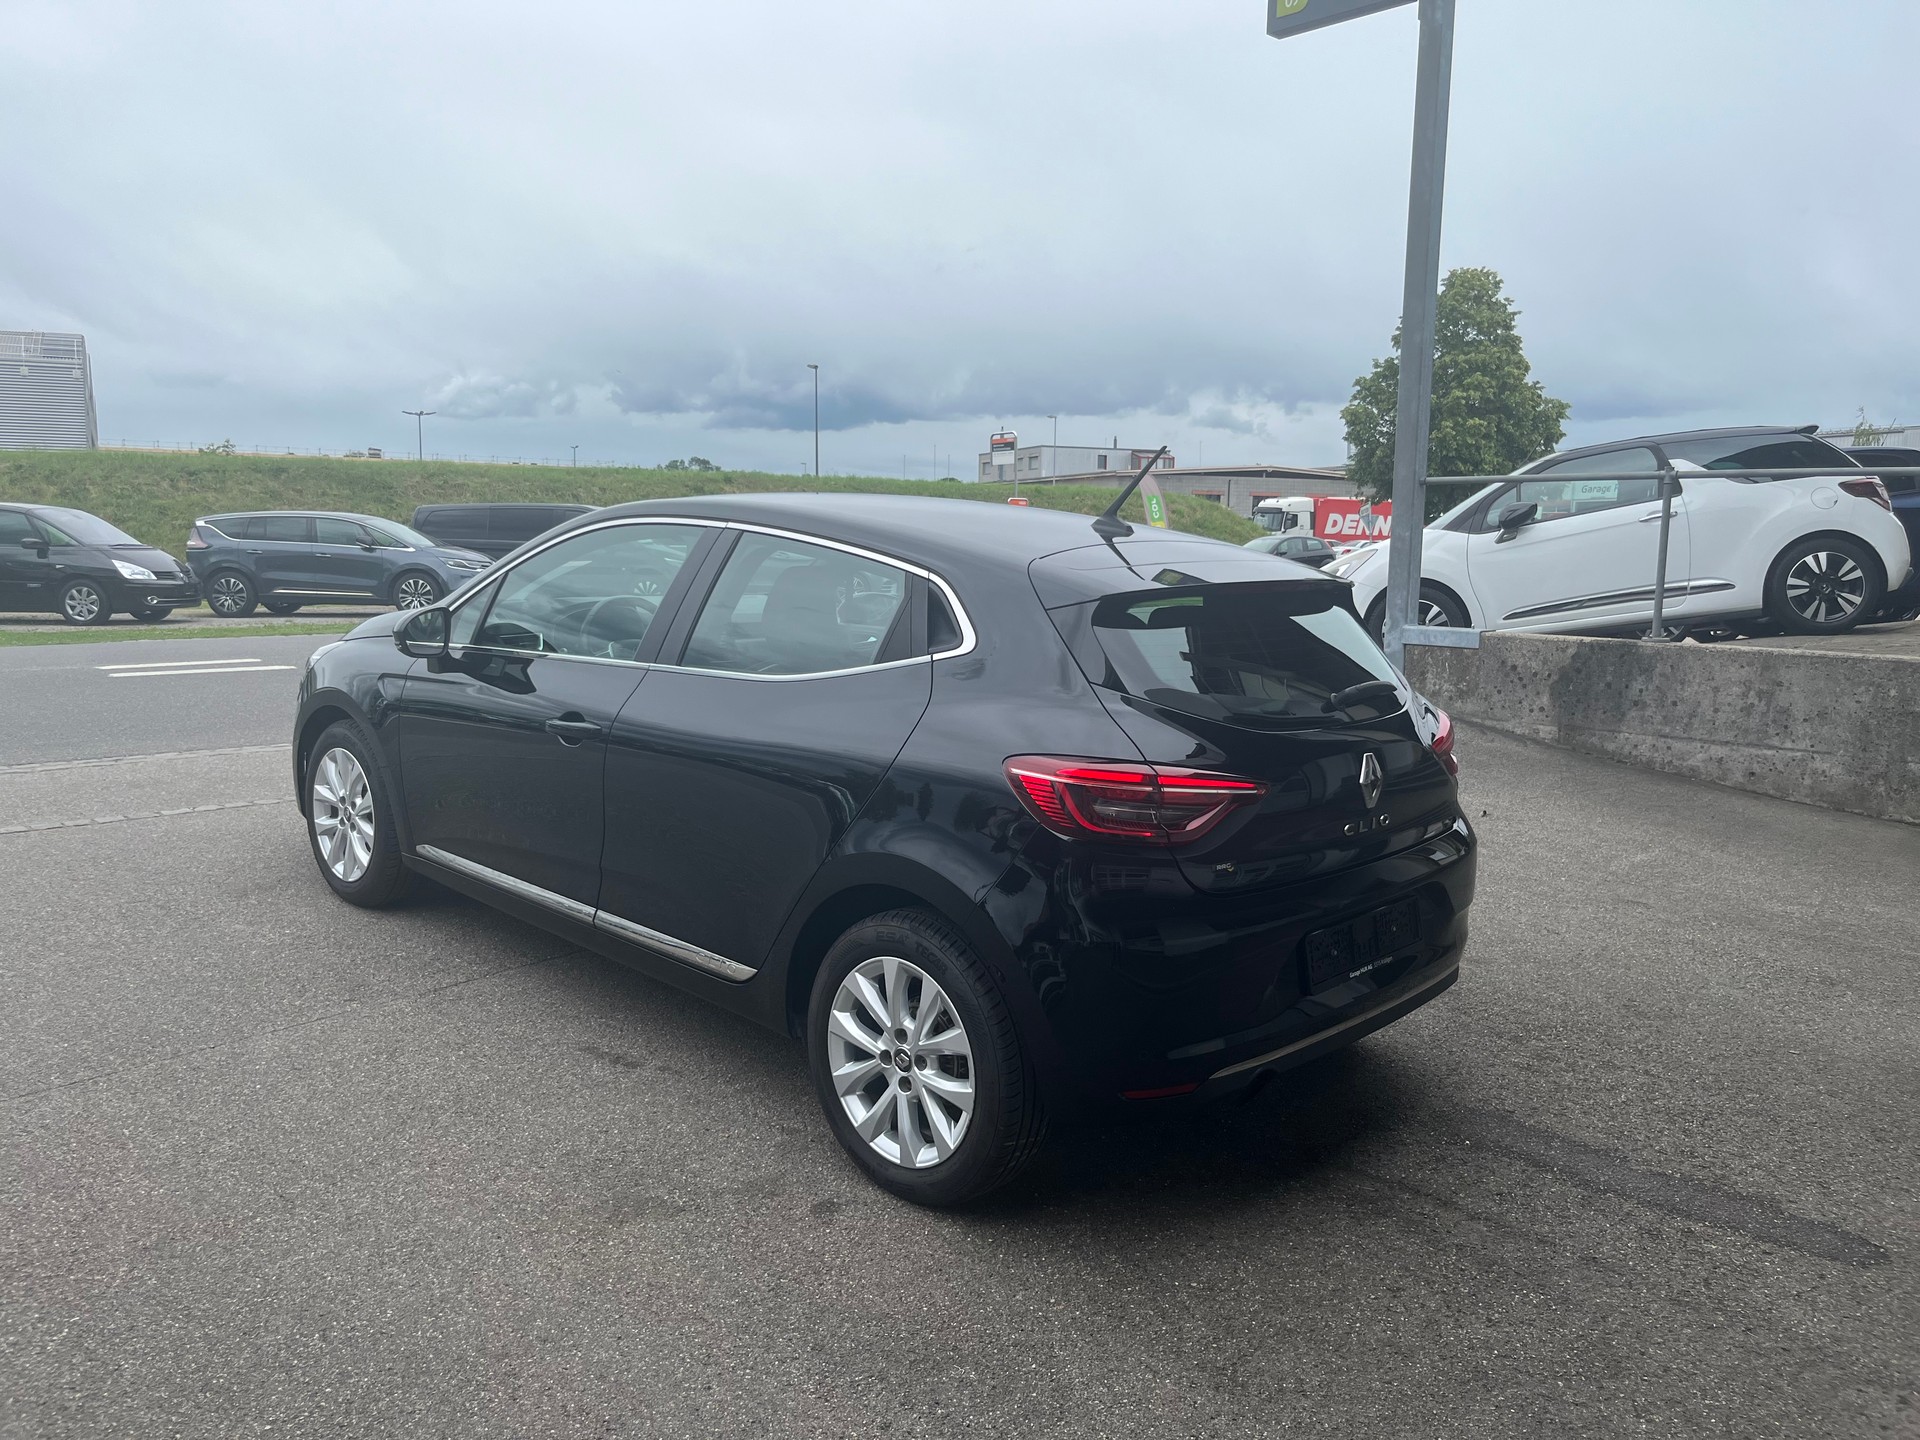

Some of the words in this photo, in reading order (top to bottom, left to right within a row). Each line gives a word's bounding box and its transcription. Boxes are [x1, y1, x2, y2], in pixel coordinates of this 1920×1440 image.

[1581, 484, 1611, 495] Garage
[1324, 513, 1392, 536] DENN
[1344, 813, 1390, 836] CLIO
